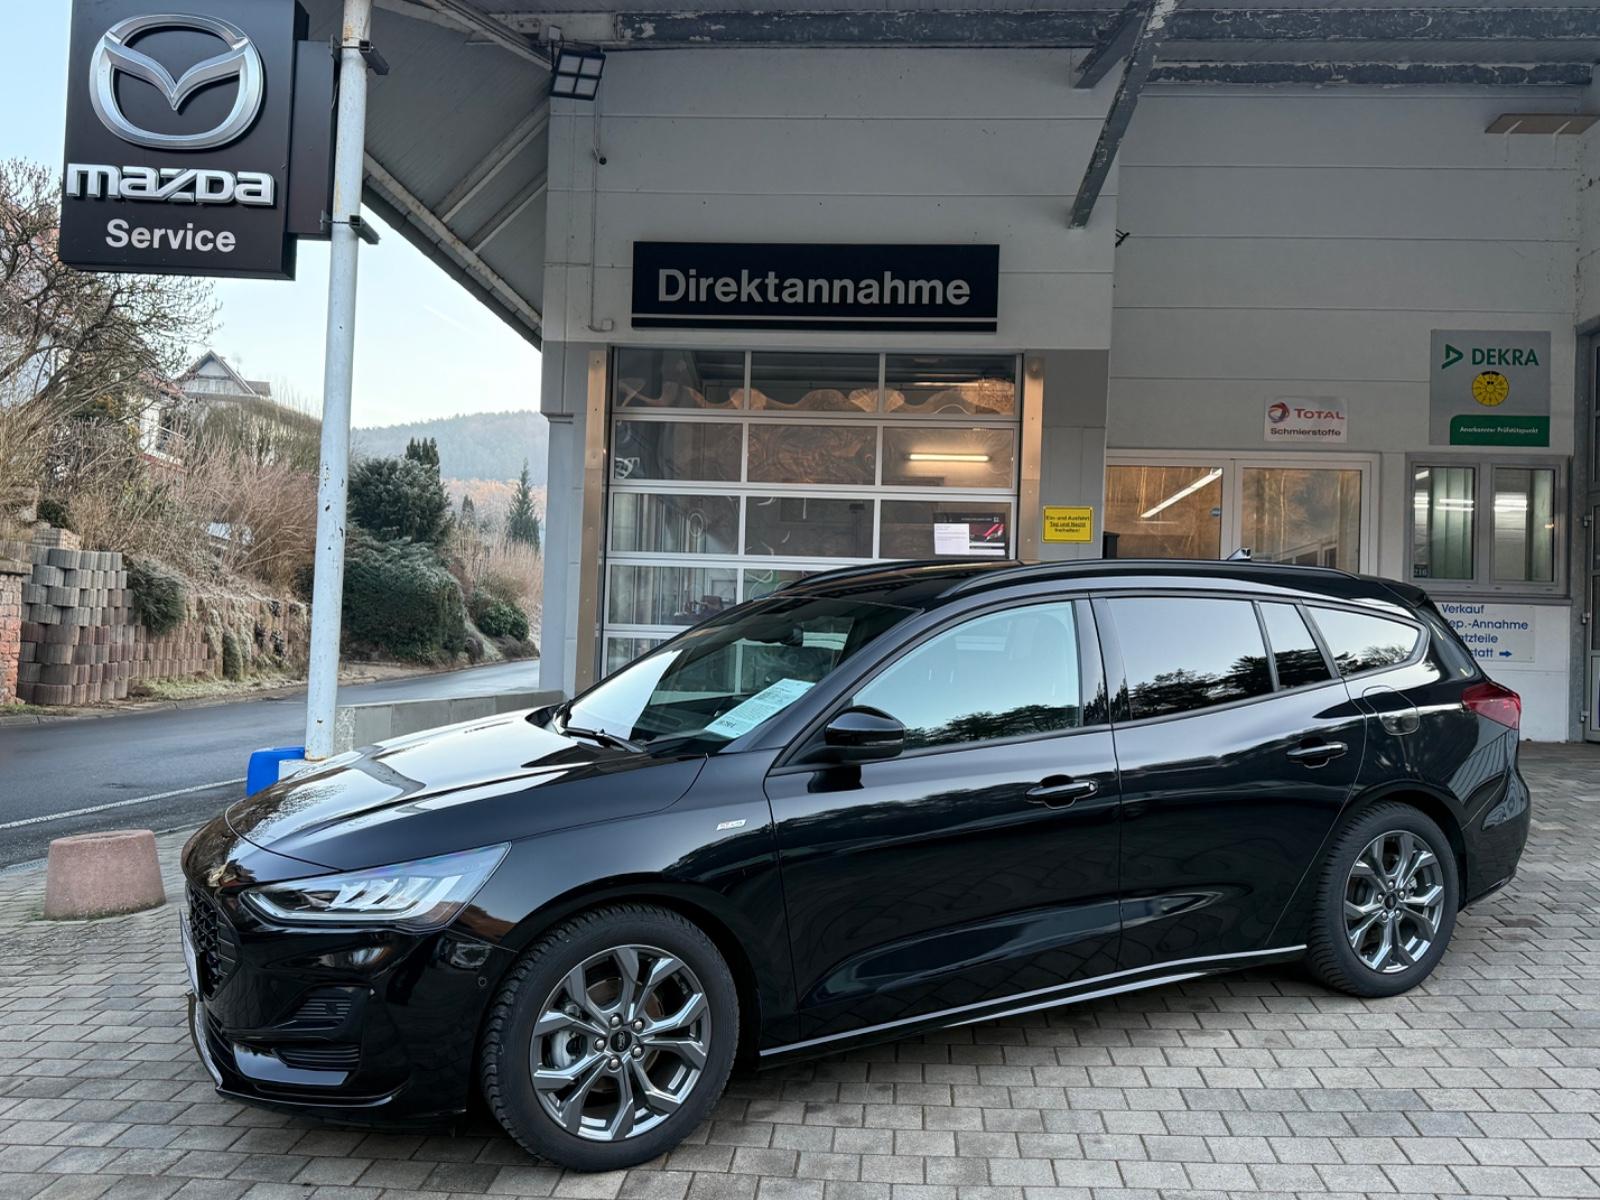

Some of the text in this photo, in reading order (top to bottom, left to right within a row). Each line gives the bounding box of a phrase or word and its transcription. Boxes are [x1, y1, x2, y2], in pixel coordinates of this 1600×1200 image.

[105, 218, 237, 254] Service
[657, 268, 971, 306] Direktannahme
[1472, 348, 1539, 366] DEKRA
[1270, 427, 1342, 437] Schmierstoffe
[1459, 425, 1496, 434] Anerkannter
[1441, 603, 1485, 615] Verkauf
[1449, 619, 1529, 630] ep.-Annahme
